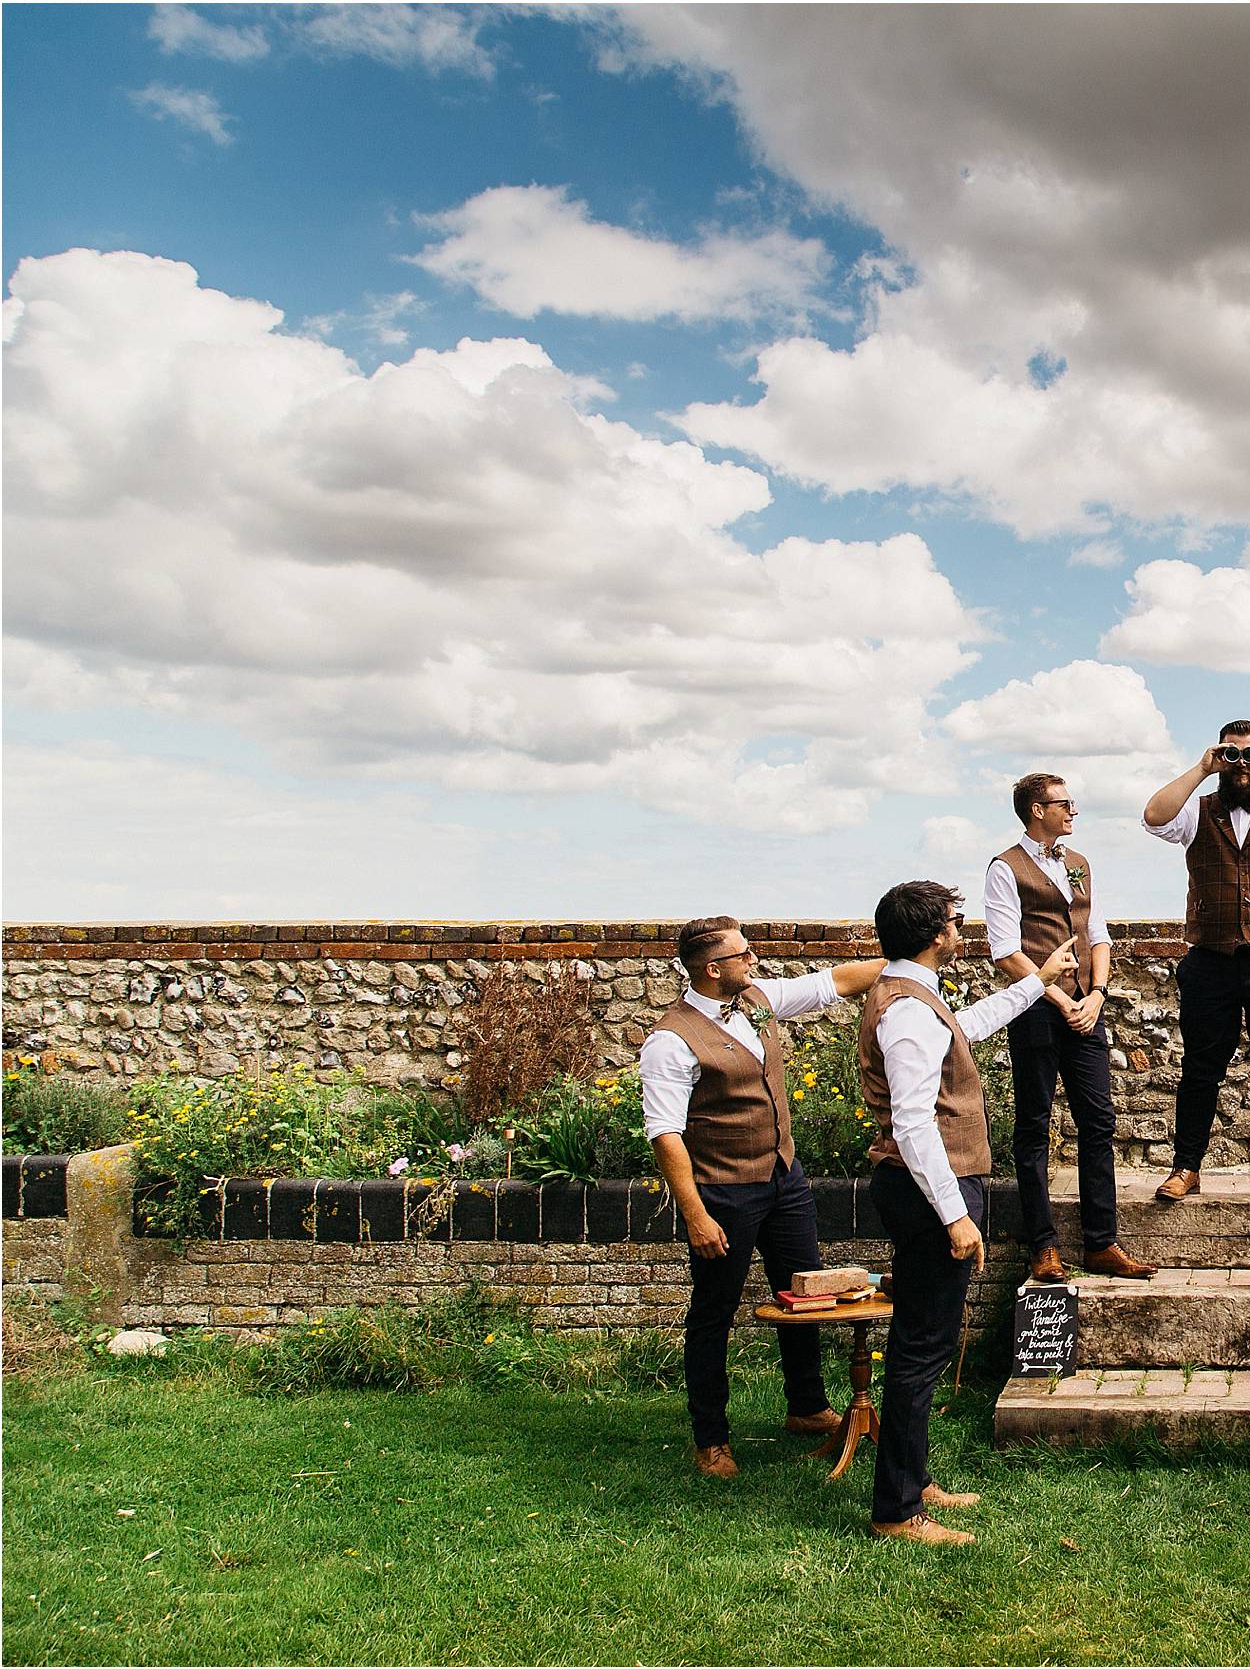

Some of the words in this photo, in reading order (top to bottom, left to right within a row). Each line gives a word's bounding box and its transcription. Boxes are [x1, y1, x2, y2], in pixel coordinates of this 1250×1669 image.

[1017, 1294, 1067, 1313] Twitchers
[1017, 1327, 1038, 1343] grab
[1037, 1329, 1062, 1339] some
[1064, 1333, 1074, 1348] &
[1015, 1348, 1034, 1361] take
[1035, 1351, 1043, 1359] a
